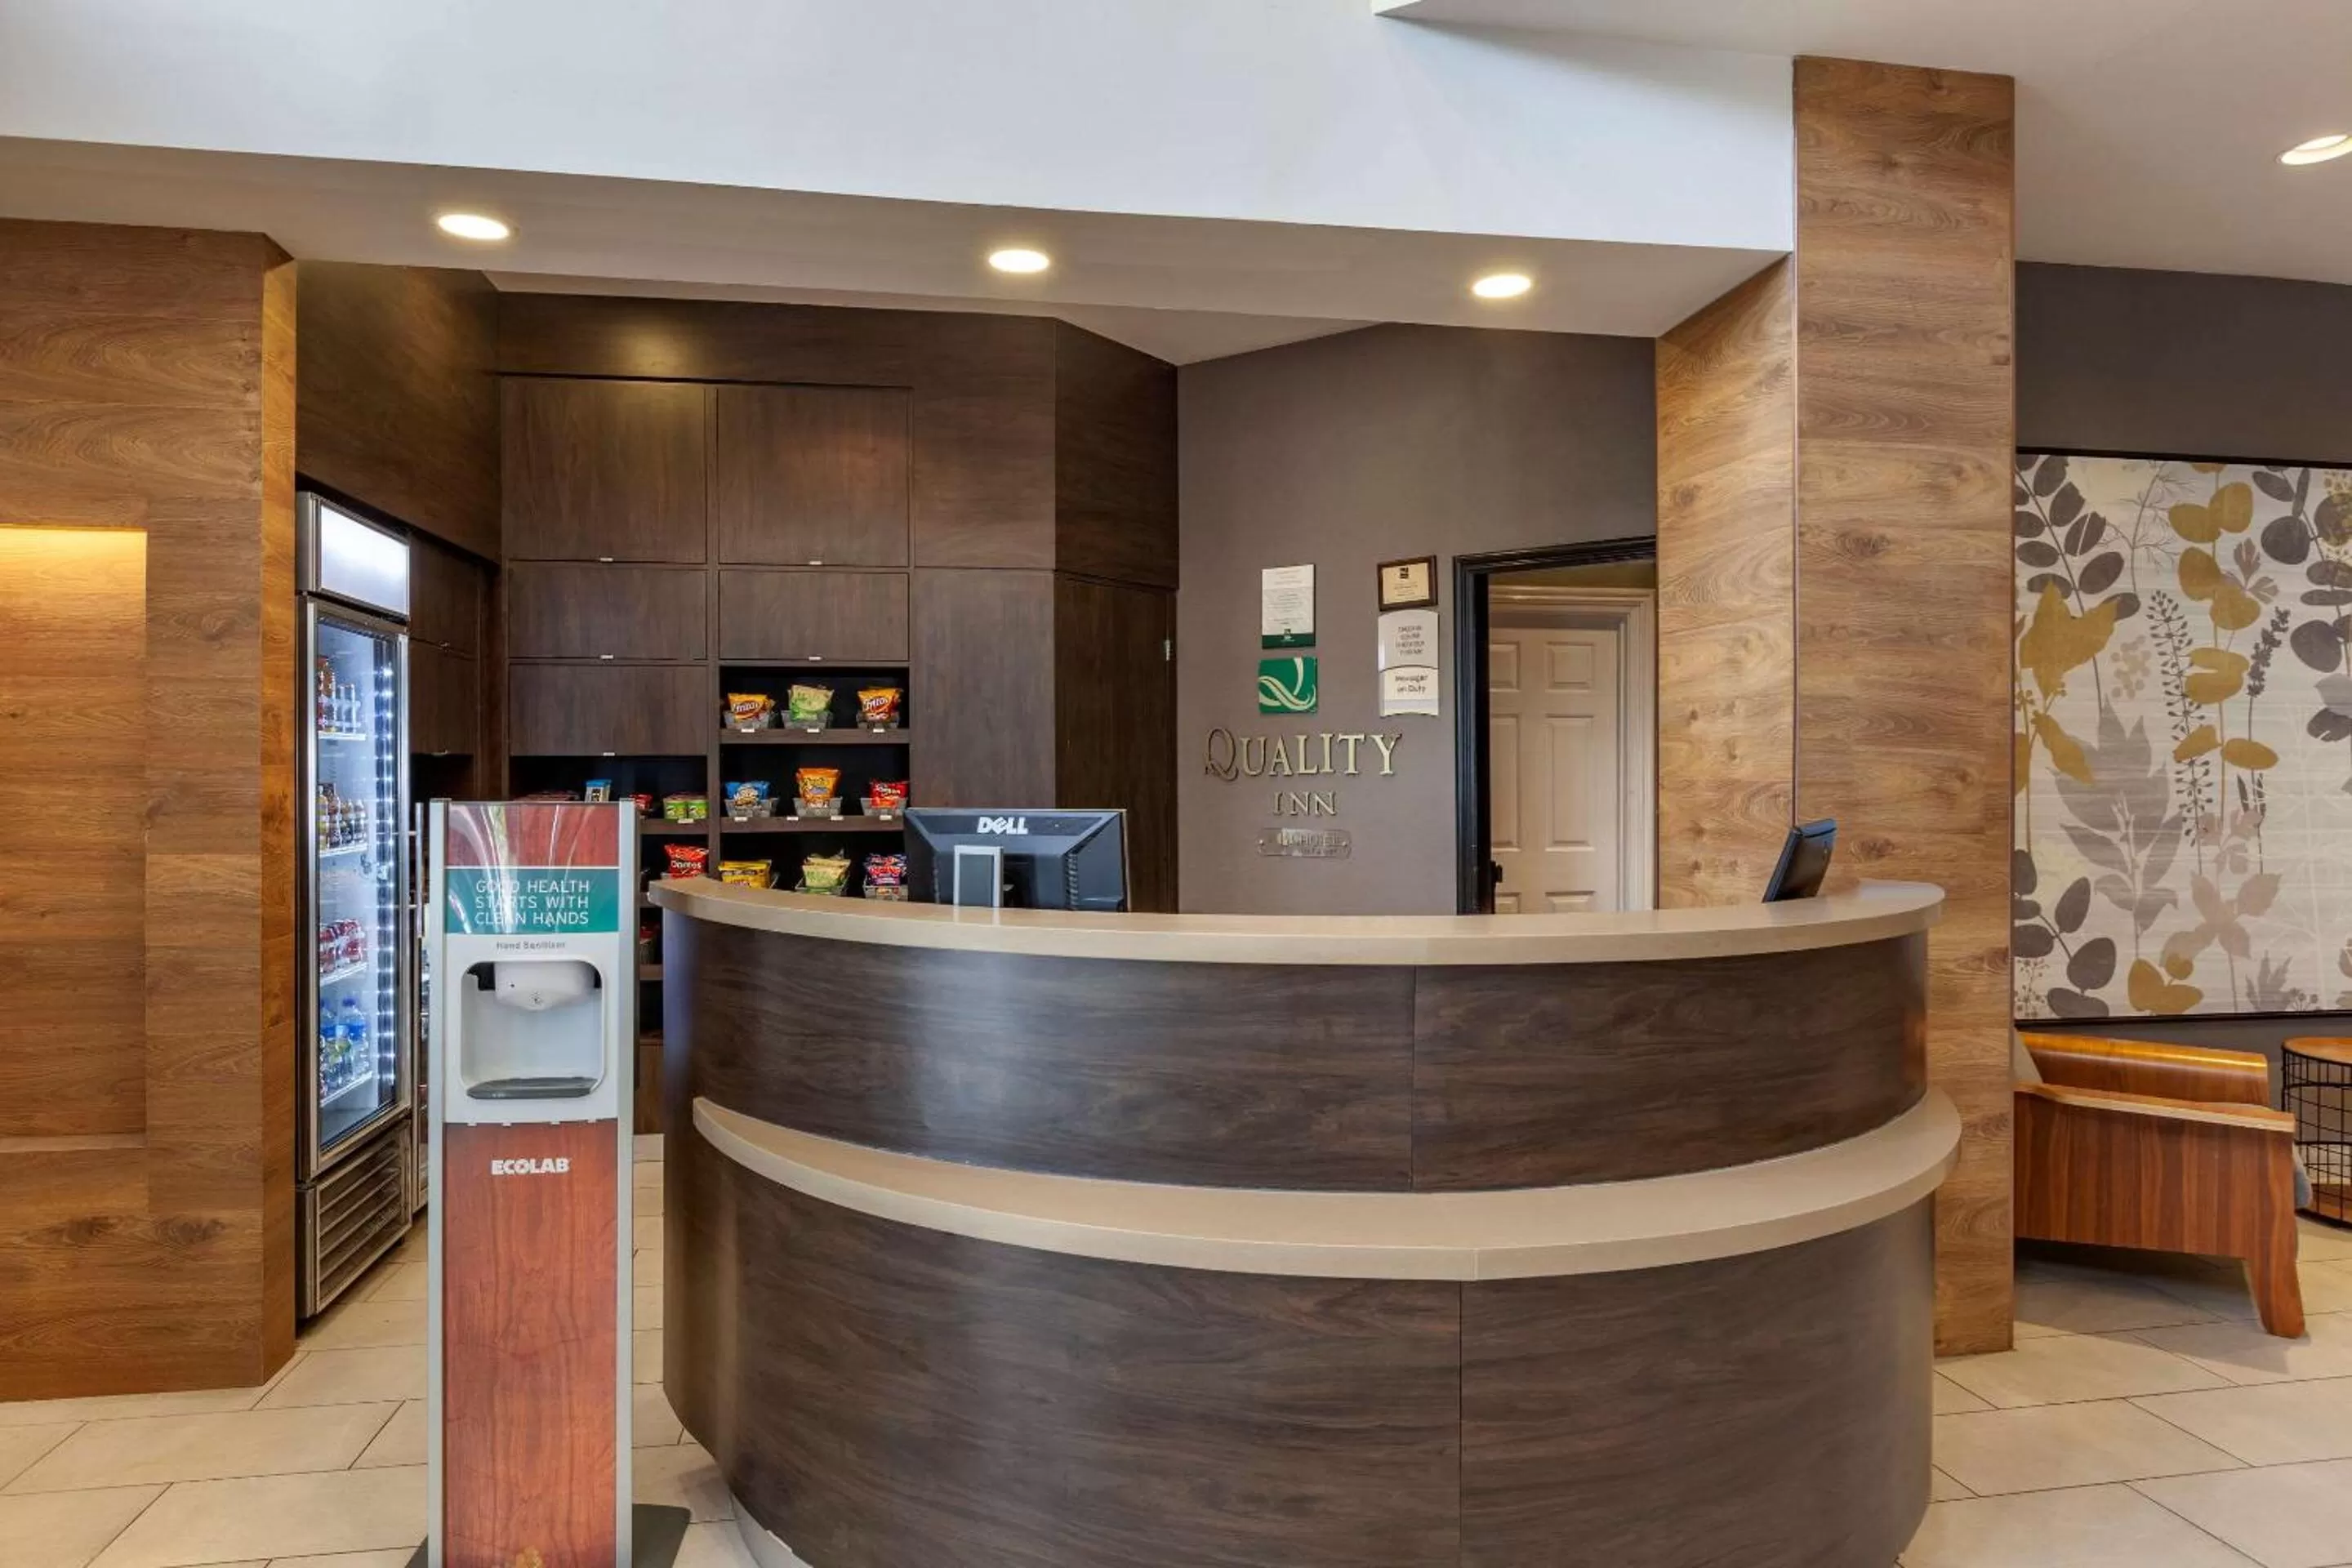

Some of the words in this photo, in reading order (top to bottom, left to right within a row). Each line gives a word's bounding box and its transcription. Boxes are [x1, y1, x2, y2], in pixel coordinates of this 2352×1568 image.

[1205, 728, 1402, 782] QUALITY
[1272, 791, 1337, 816] INN
[977, 817, 1029, 835] DELL
[476, 880, 520, 893] GOD
[527, 880, 590, 893] HEALTH
[545, 895, 590, 909] WITH
[474, 911, 527, 925] CLEN
[532, 911, 590, 925] HANDS
[492, 1157, 570, 1175] ECOLAB
